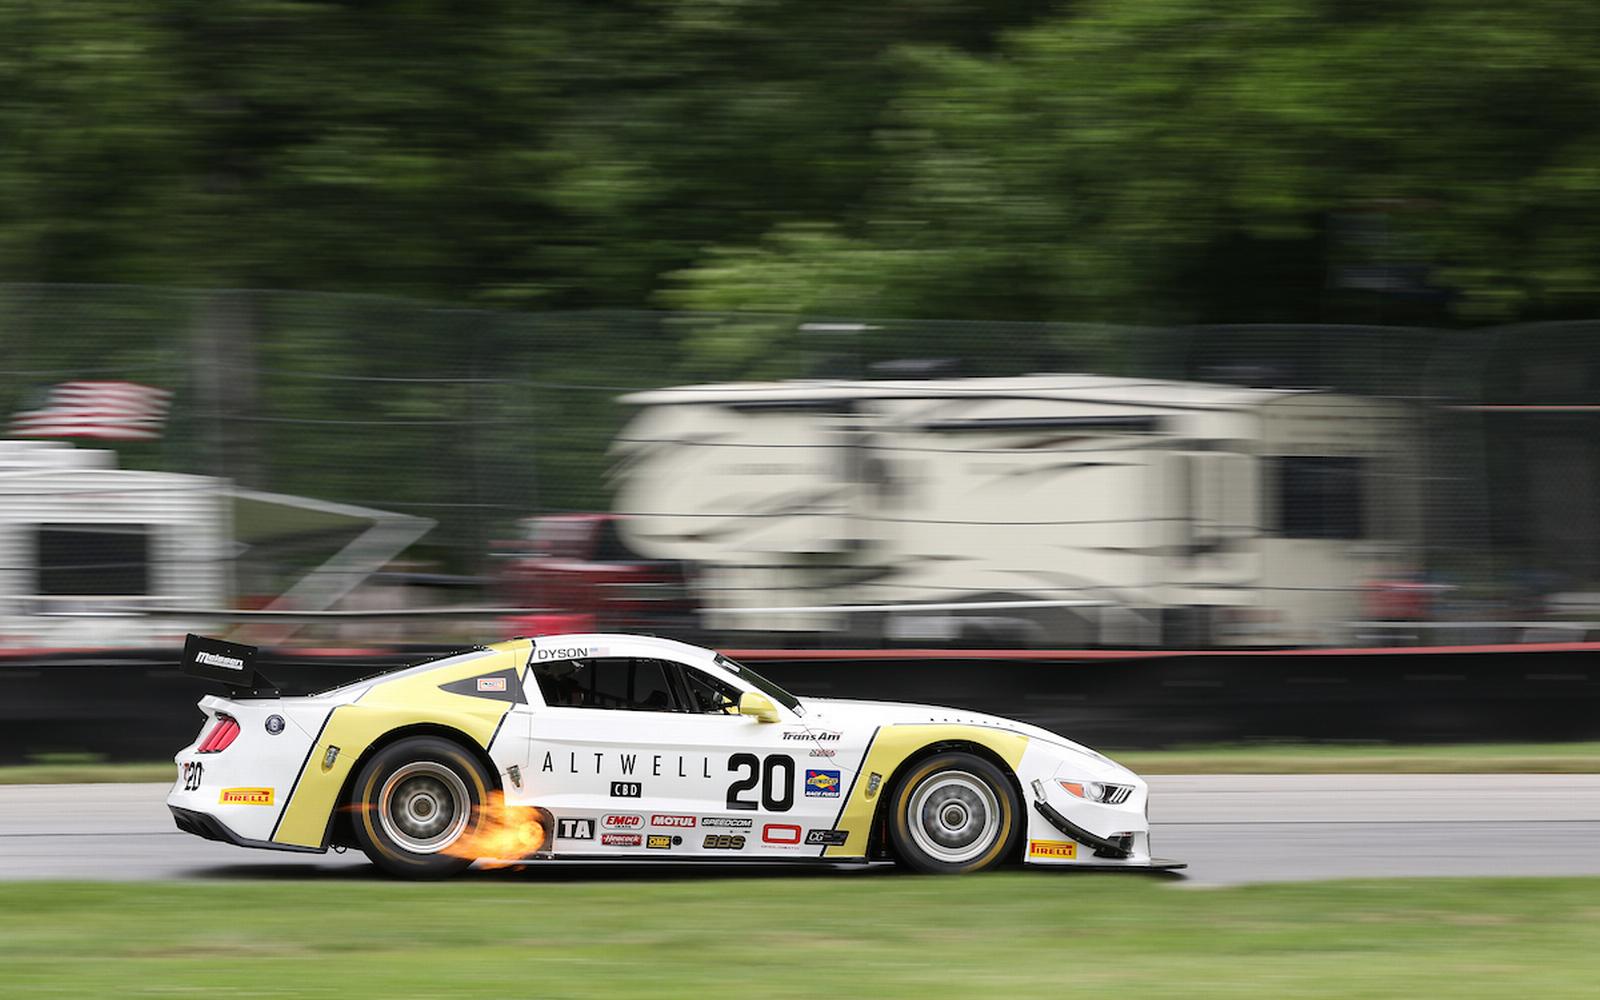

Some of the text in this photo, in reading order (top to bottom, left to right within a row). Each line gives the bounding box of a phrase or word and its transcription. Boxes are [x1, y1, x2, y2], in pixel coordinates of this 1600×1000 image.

[538, 647, 588, 660] DYSON
[542, 751, 712, 779] ALTWELL
[184, 761, 203, 791] 20
[726, 752, 795, 812] 20
[614, 783, 638, 796] CBD
[223, 791, 270, 802] PIRELLI
[605, 815, 640, 826] EMCO
[652, 815, 695, 827] MOTUL
[702, 817, 752, 828] SPEEDCOM
[561, 820, 592, 839] TA
[648, 837, 670, 847] OMP
[703, 835, 746, 849] BBS
[1031, 843, 1073, 856] PIRELLI
